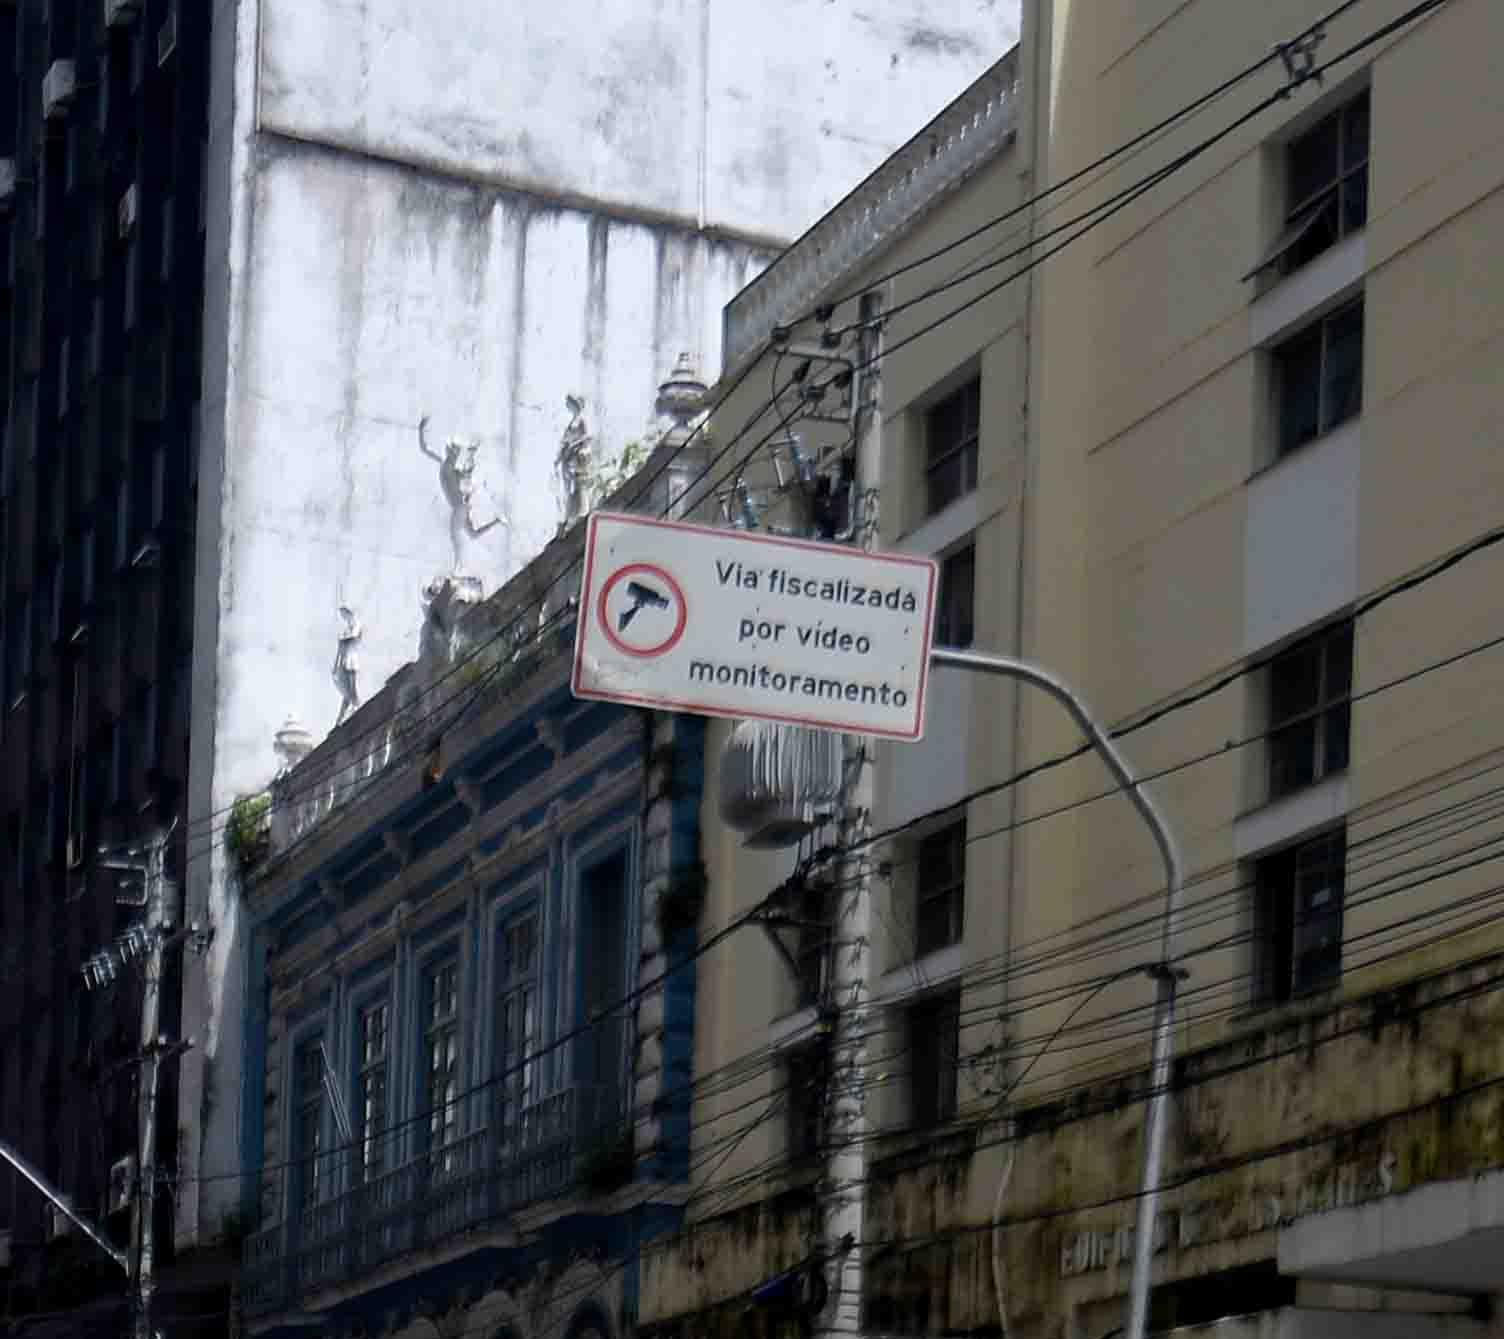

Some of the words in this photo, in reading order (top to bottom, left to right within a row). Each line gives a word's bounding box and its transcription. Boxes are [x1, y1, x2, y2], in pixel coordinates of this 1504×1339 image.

[716, 559, 760, 590] Via
[768, 567, 918, 614] fiscalizada
[738, 618, 786, 643] por
[796, 620, 872, 656] vídeo
[689, 659, 909, 709] monitoramento
